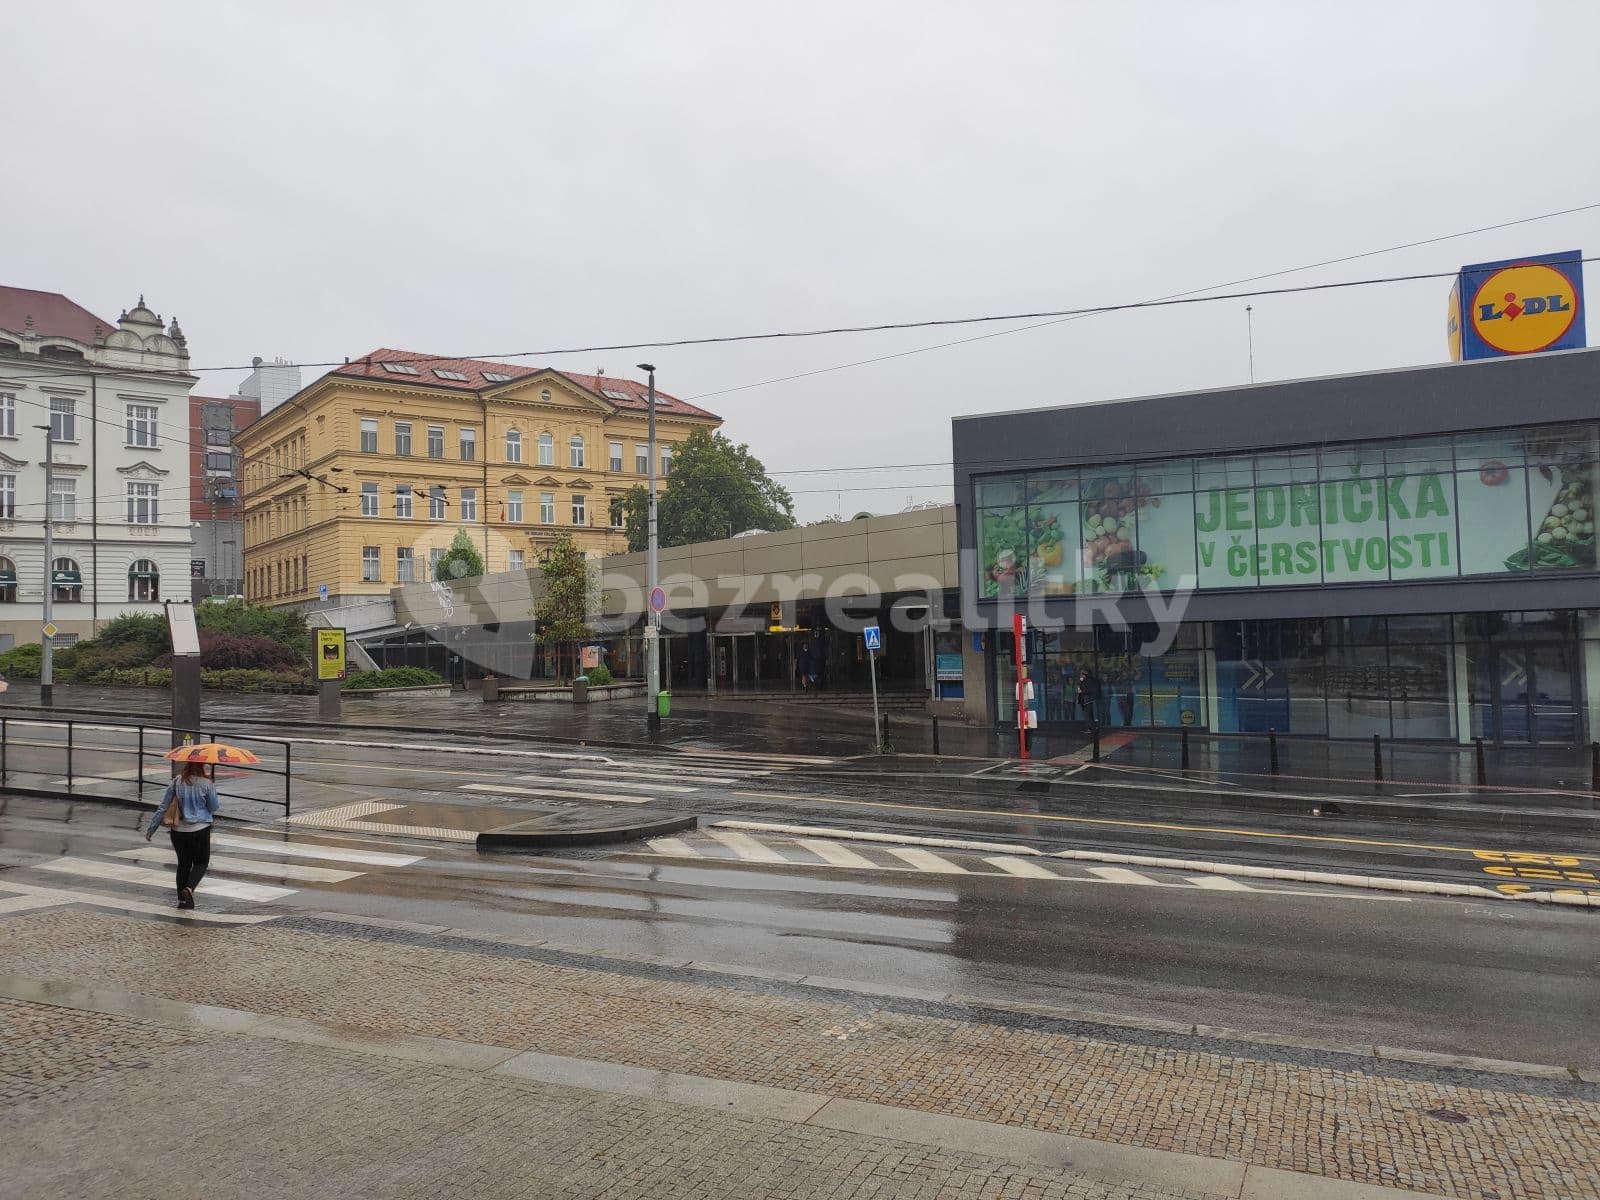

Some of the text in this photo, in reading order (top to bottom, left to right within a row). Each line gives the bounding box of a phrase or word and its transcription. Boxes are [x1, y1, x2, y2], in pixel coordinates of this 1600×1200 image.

[1196, 463, 1449, 532] JEDNIČKA
[1200, 531, 1450, 577] V ČERSTVOSTI
